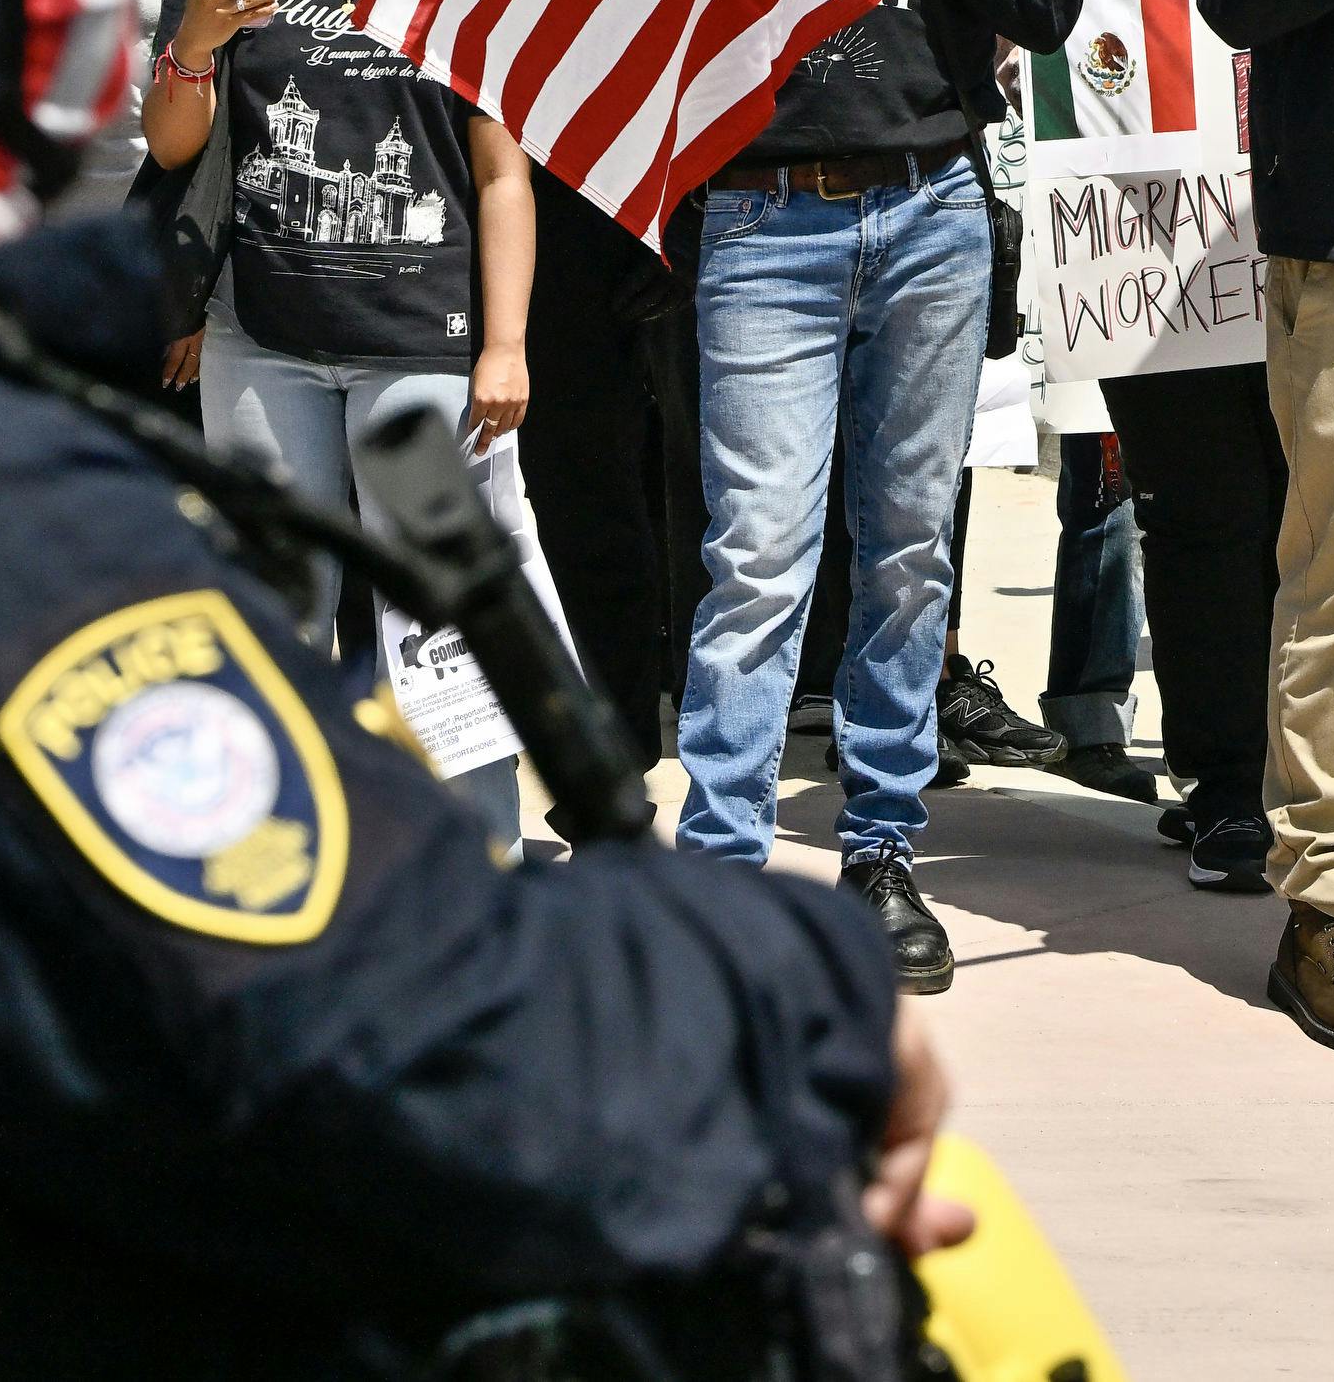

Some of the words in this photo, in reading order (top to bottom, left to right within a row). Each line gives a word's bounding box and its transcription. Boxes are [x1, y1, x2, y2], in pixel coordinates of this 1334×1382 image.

[300, 45, 333, 66] Y
[328, 49, 371, 63] aunque
[373, 45, 387, 59] la
[344, 68, 359, 78] no
[361, 63, 397, 81] dejaré
[399, 63, 415, 78] de
